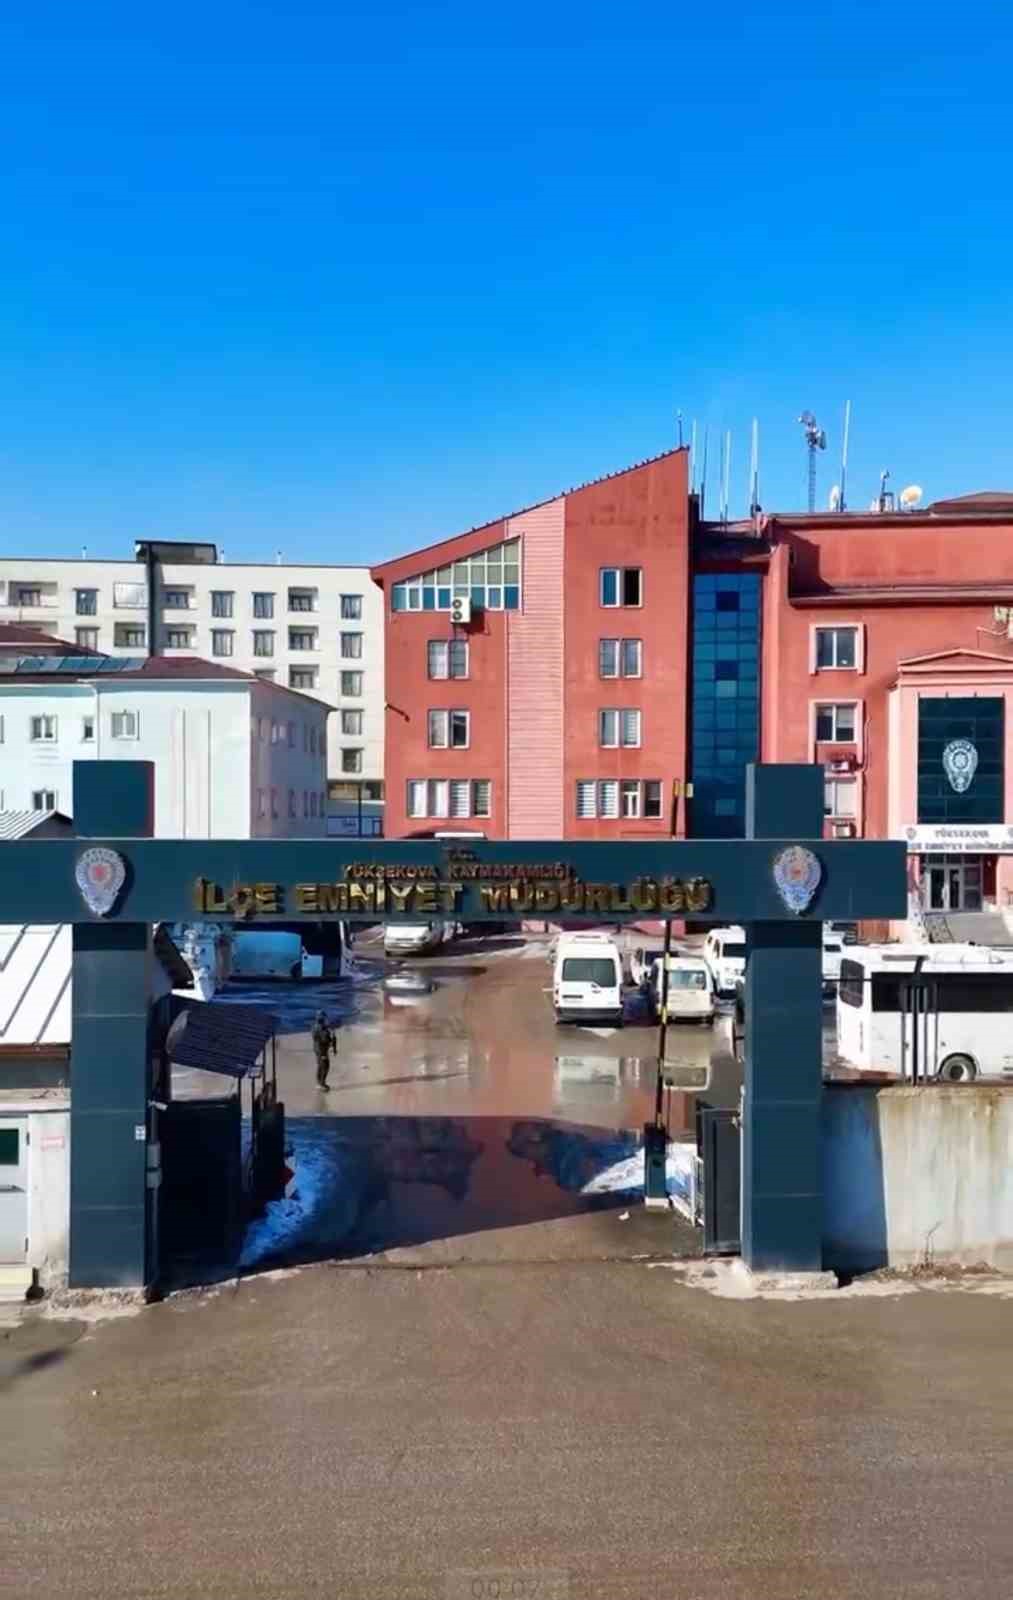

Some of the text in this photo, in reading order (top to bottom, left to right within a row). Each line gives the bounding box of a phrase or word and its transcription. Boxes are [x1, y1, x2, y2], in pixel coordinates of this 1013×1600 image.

[194, 876, 712, 918] İLÇE EMNİYET MÜDÜRLÜĞÜ
